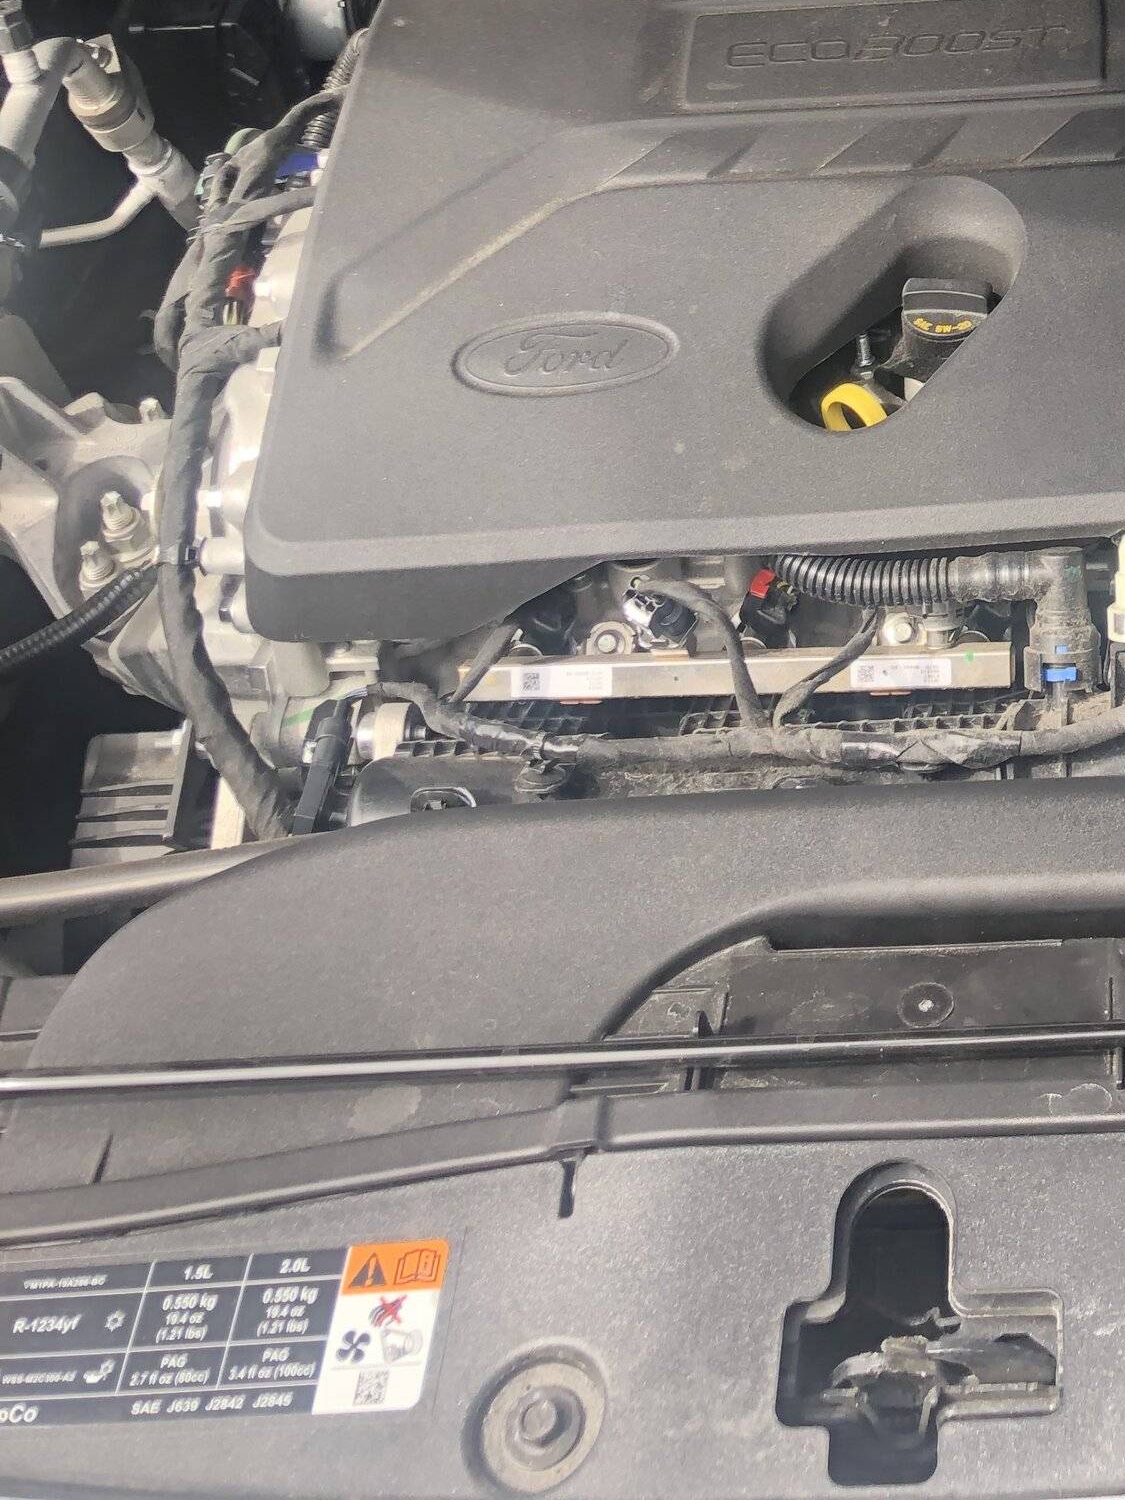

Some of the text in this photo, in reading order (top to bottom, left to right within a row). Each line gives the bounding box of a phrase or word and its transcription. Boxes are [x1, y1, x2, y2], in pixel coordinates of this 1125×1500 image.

[726, 24, 1066, 68] ECOBOOST
[503, 331, 628, 376] Ford
[184, 1264, 214, 1280] 1.5L
[279, 1257, 311, 1274] 2.0L
[199, 1293, 219, 1311] kg
[300, 1286, 319, 1305] kg
[189, 1312, 204, 1324] oz
[290, 1304, 306, 1317] oz
[13, 1314, 83, 1334] R-1234yf
[160, 1352, 189, 1369] PAG
[262, 1347, 291, 1363] PAG
[158, 1372, 173, 1385] oz
[257, 1364, 274, 1379] oz
[130, 1399, 163, 1415] SAE
